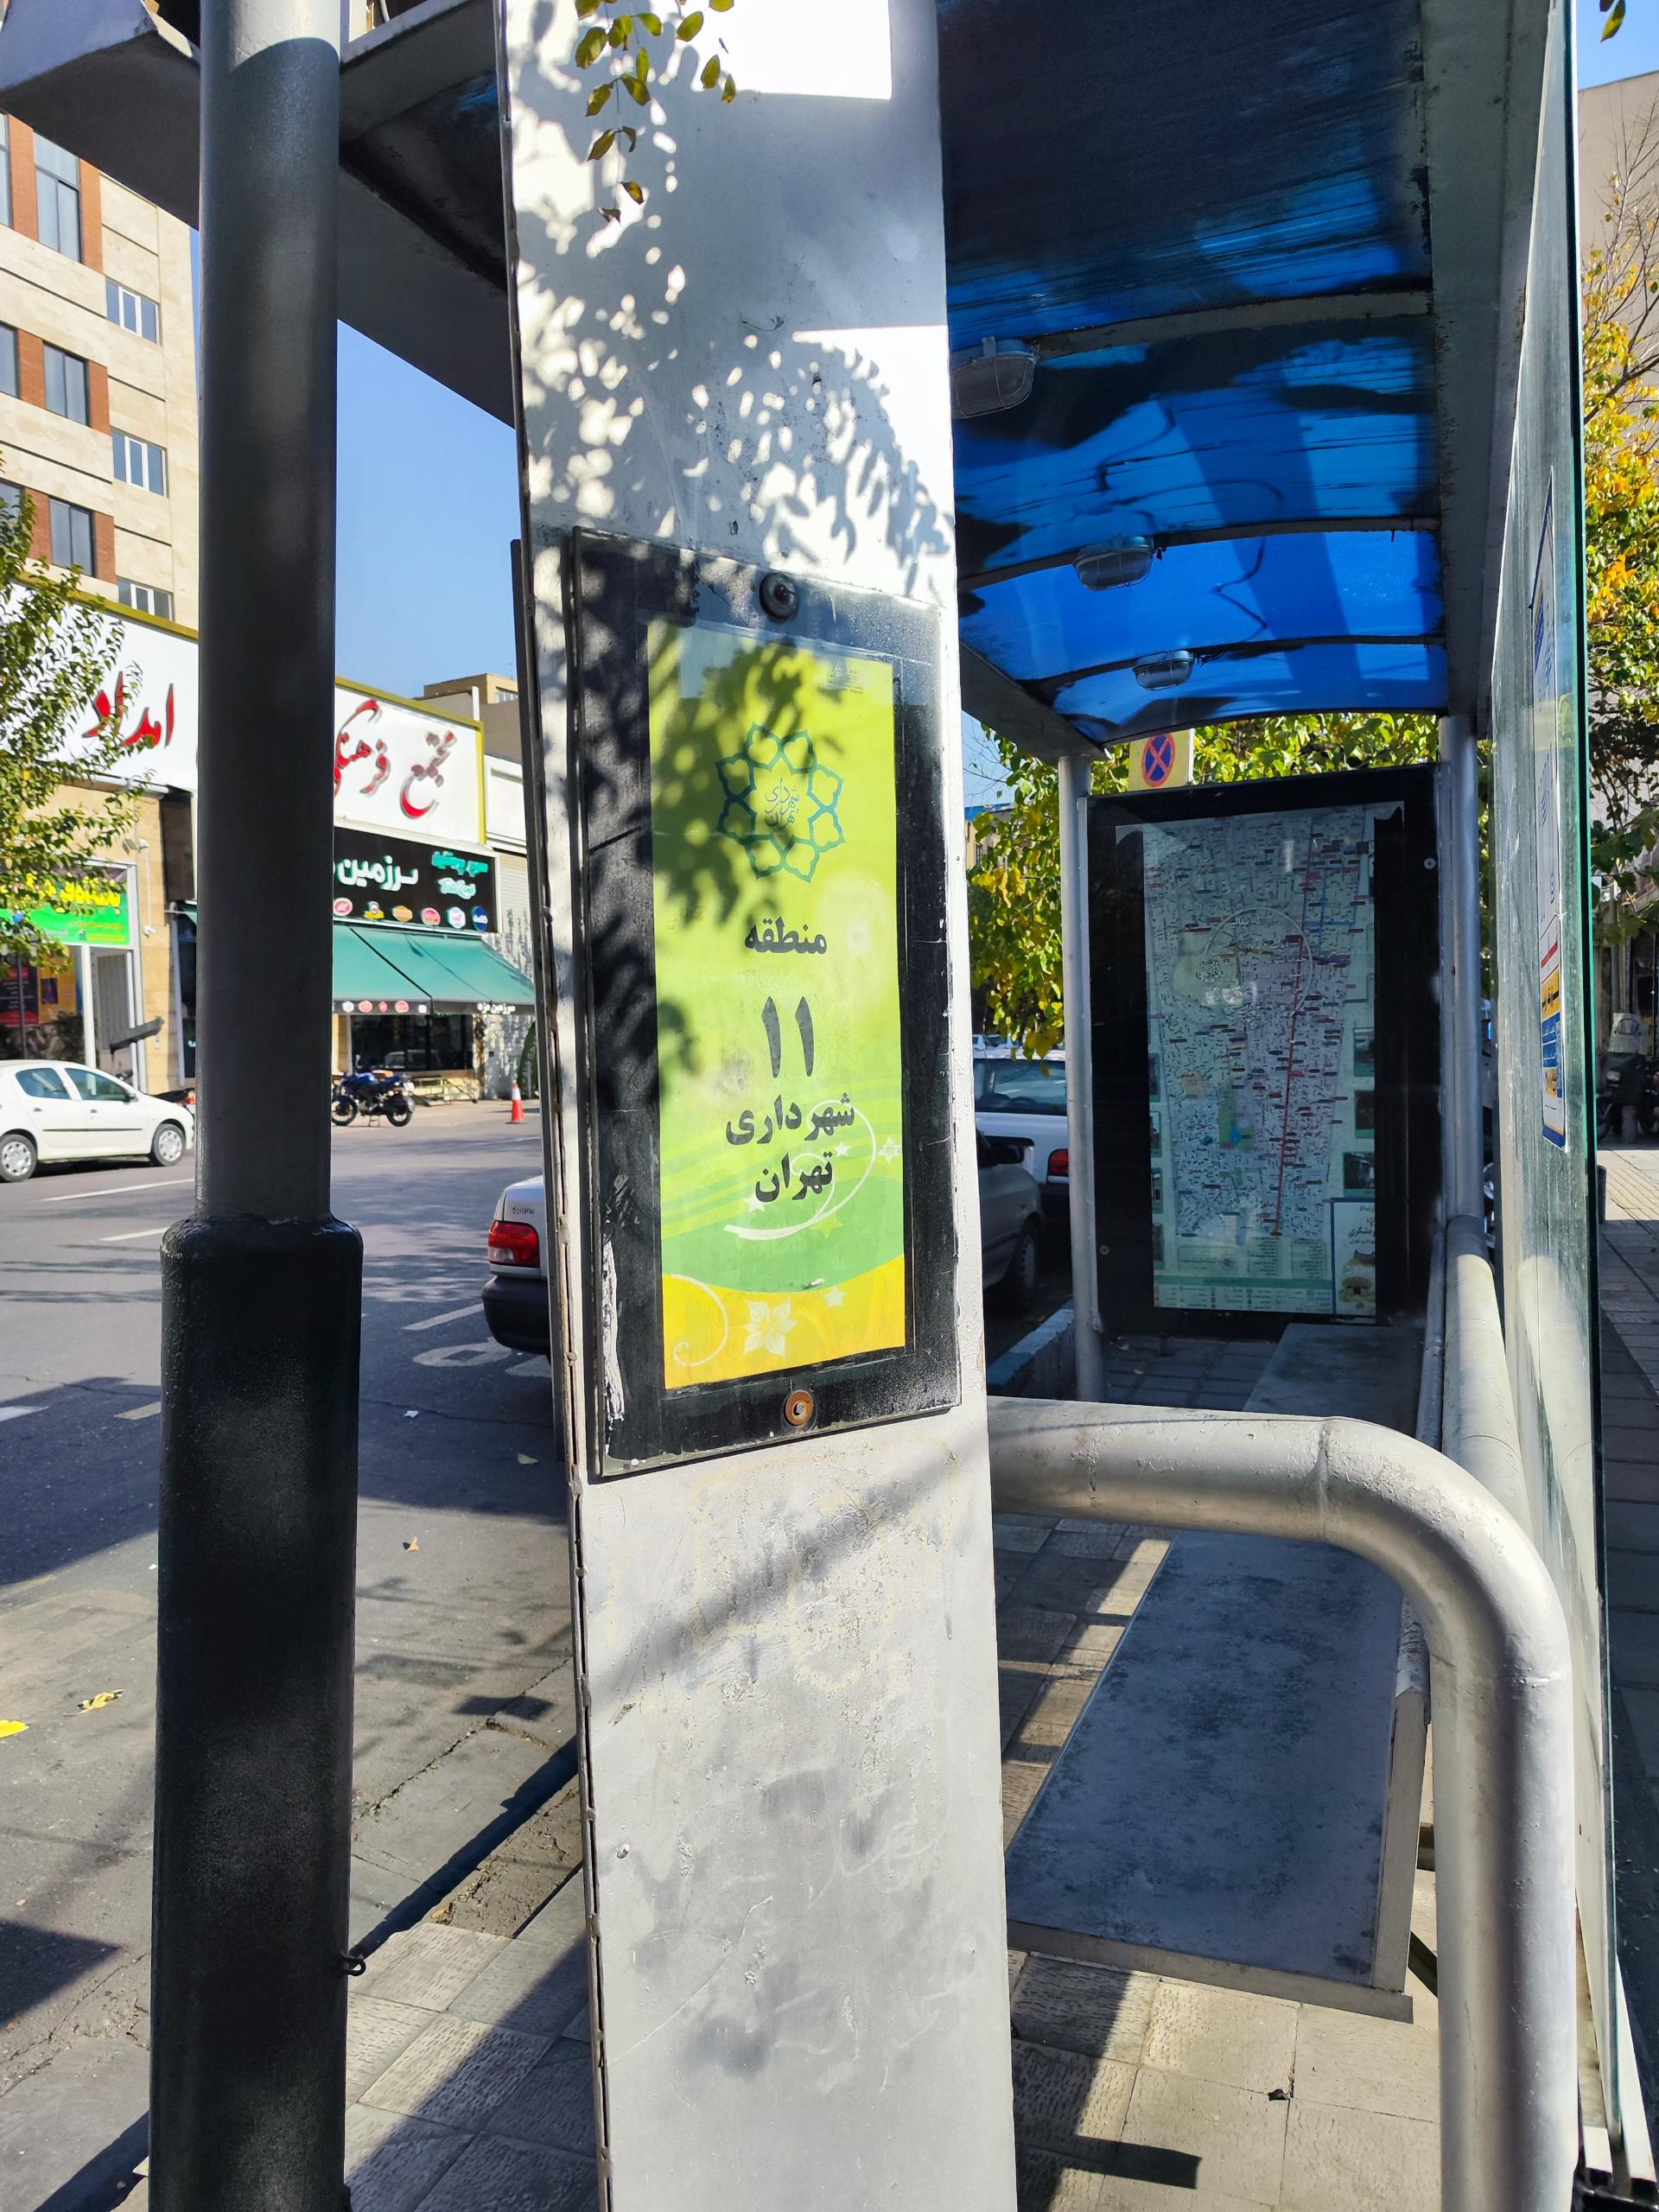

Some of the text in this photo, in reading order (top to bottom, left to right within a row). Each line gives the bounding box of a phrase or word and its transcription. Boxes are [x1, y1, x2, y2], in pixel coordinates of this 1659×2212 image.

[400, 730, 458, 820] مجتمع
[336, 855, 419, 892] سرزمین
[745, 916, 828, 955] منطقه
[761, 996, 815, 1079] ۱۱
[726, 1093, 855, 1146] شهرداری
[755, 1152, 833, 1204] تهران
